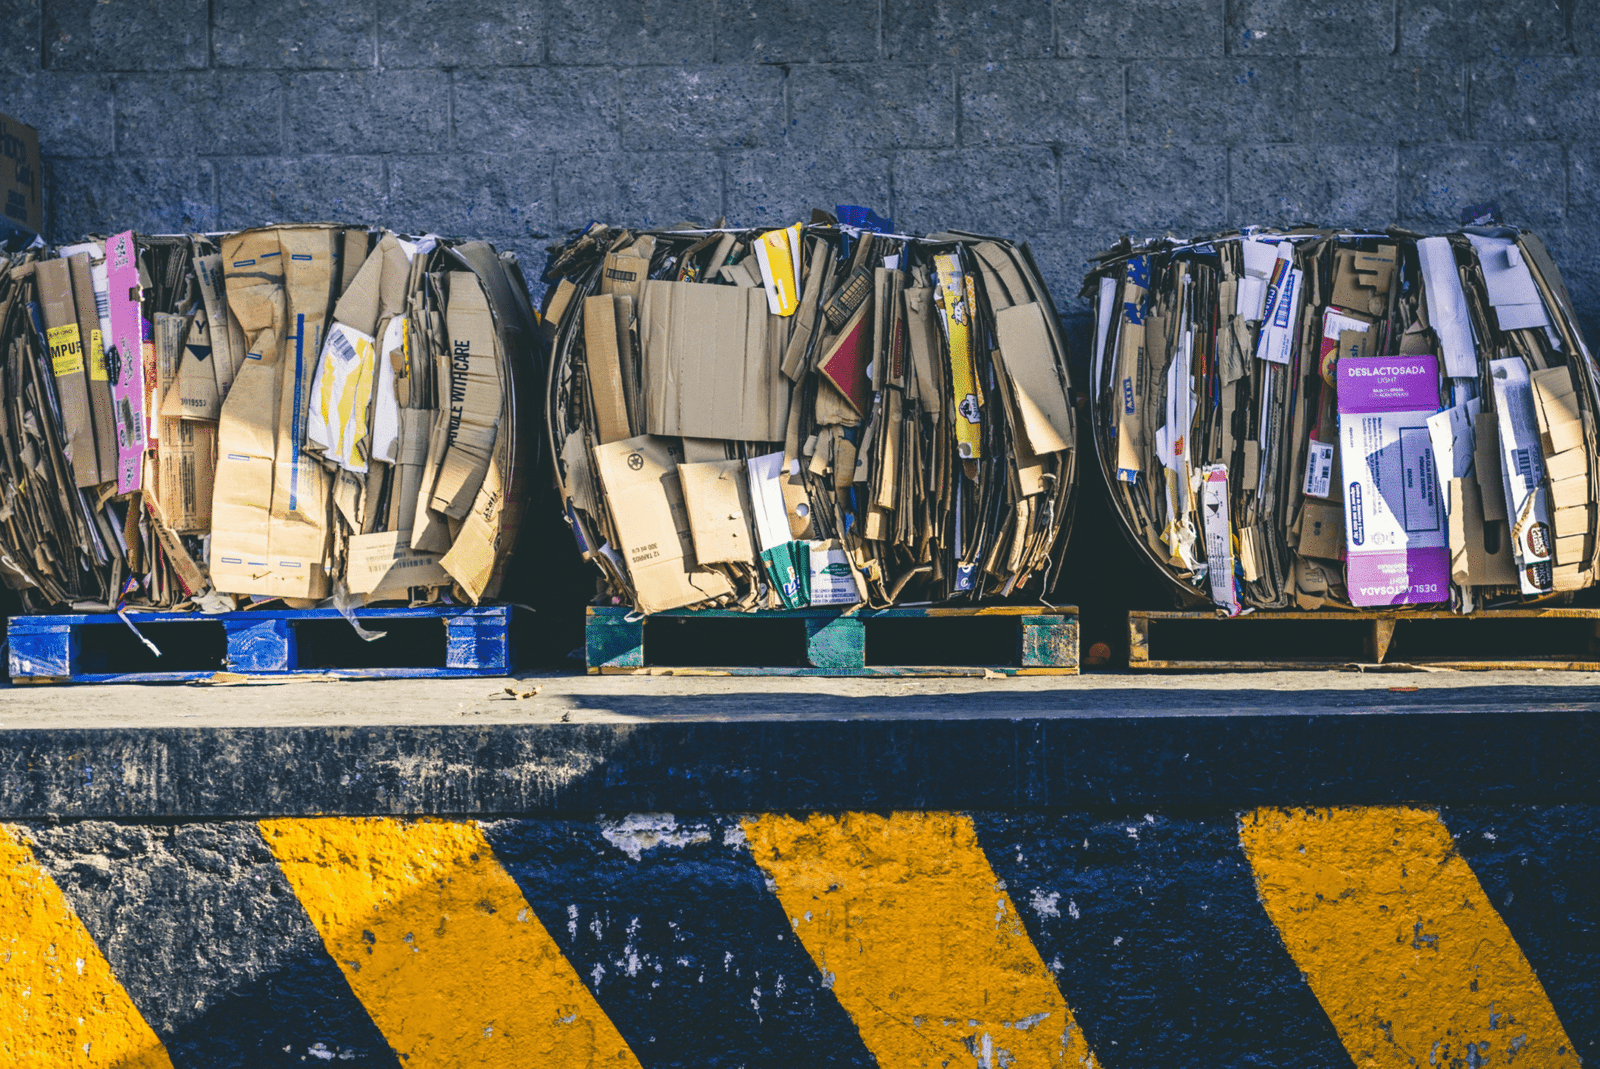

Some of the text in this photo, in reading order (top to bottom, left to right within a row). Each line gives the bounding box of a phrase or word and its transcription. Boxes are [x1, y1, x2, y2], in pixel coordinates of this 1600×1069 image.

[1348, 366, 1426, 378] DESLACTOSADA
[448, 340, 470, 446] ANDLE WITH CARE
[1360, 584, 1437, 596] DESLACTOSADA
